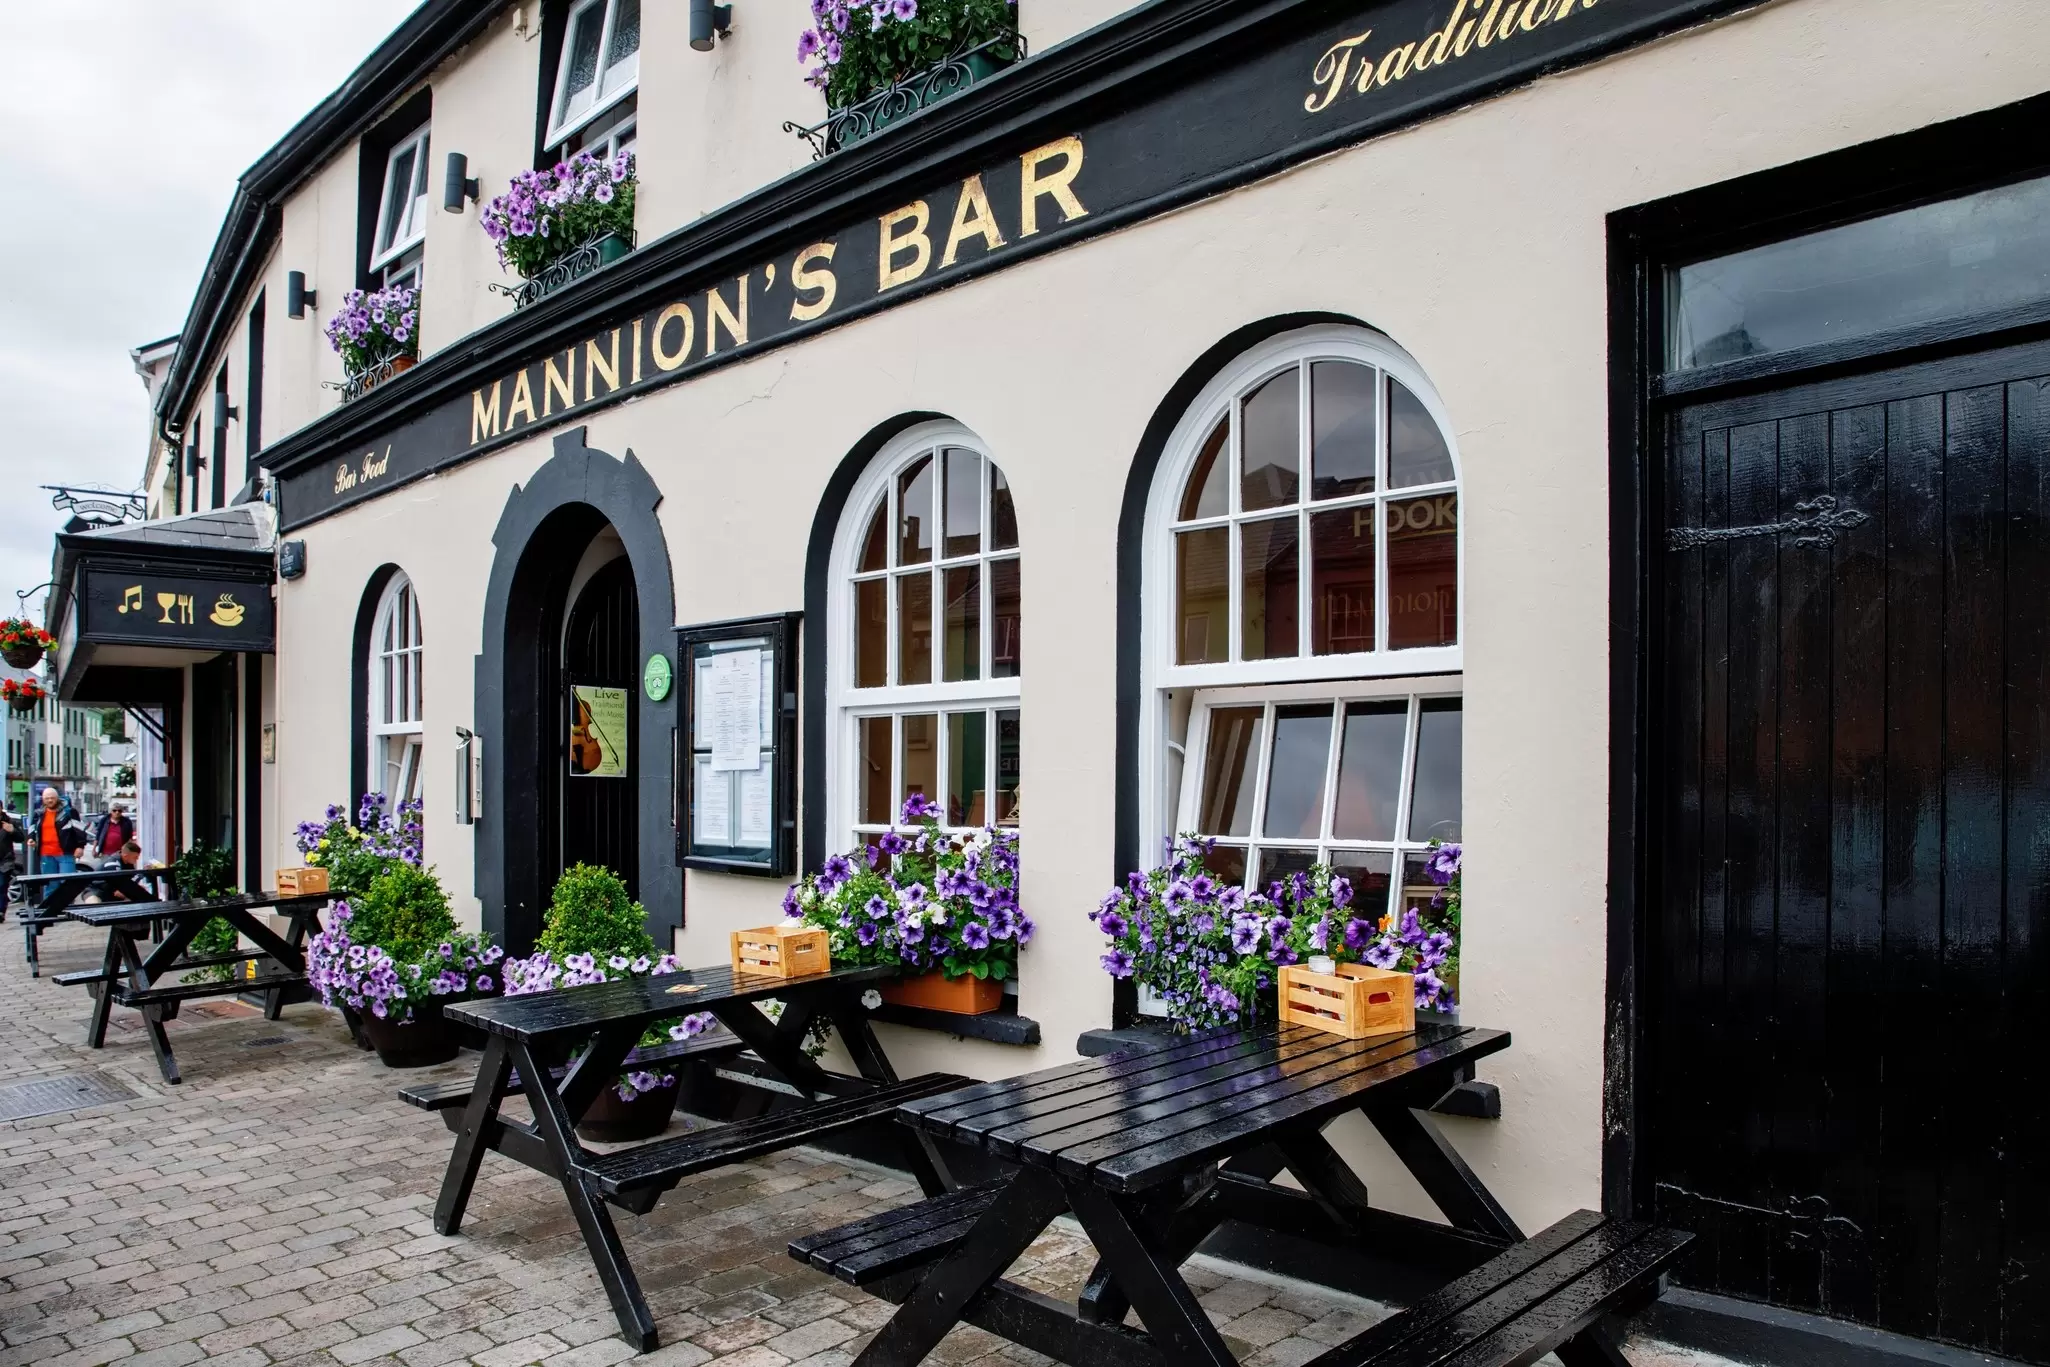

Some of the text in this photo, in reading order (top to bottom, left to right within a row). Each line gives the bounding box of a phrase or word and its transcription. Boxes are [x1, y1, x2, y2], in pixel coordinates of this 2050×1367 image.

[470, 135, 1089, 445] MANNION'S BAR
[334, 444, 392, 494] Bar Food
[595, 689, 620, 700] Live
